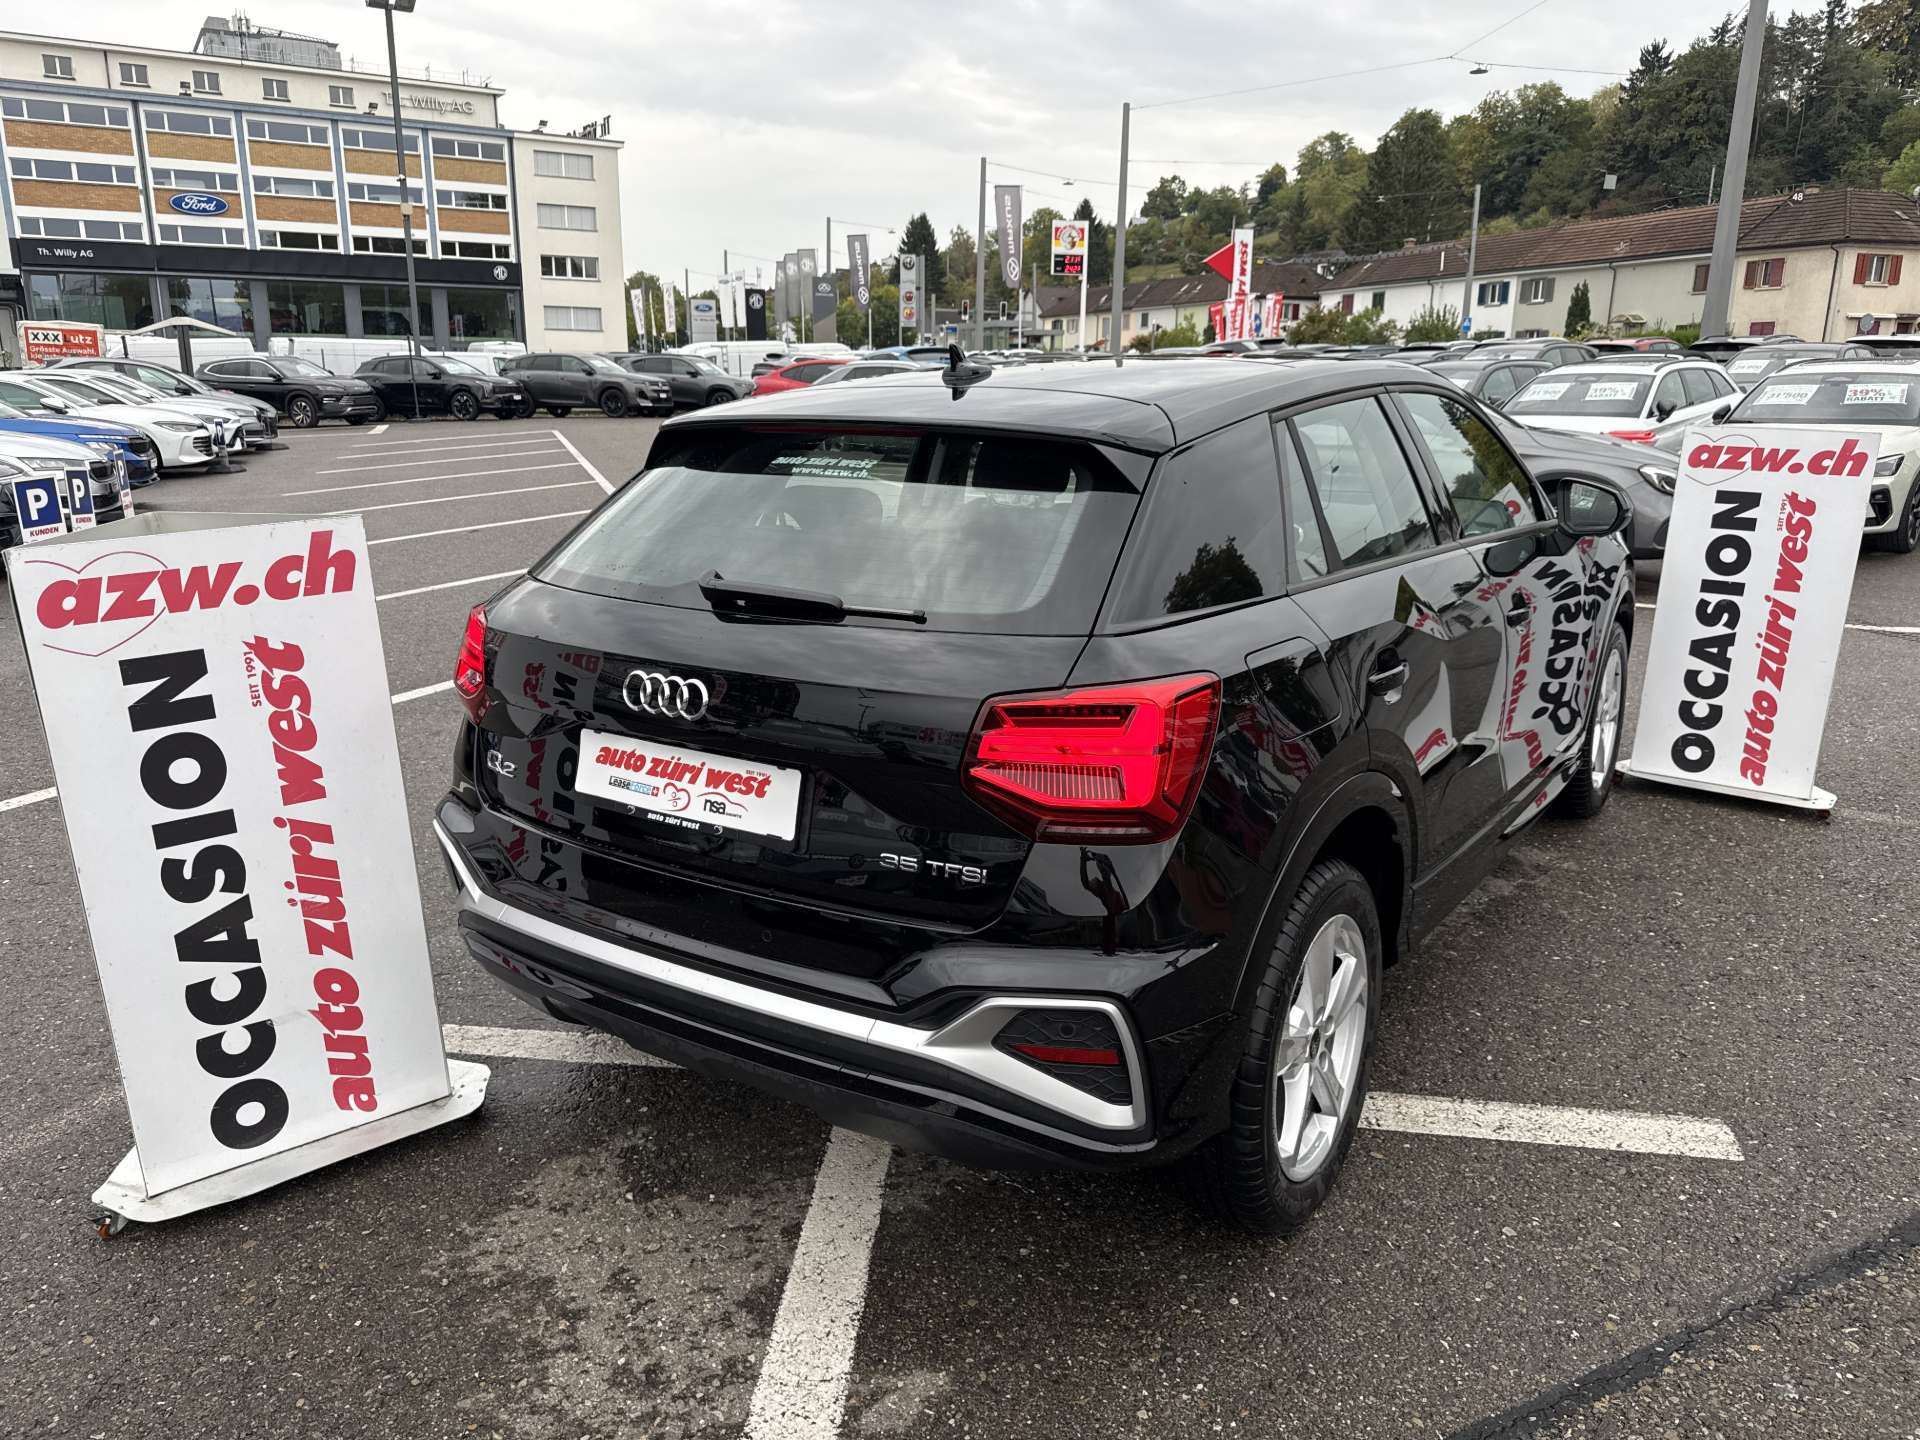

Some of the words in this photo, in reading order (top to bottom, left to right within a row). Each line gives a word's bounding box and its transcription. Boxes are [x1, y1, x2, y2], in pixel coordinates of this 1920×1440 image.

[411, 95, 446, 114] Willy
[452, 99, 474, 113] AG
[181, 195, 217, 211] Ford
[1792, 192, 1804, 201] 48
[37, 247, 51, 256] Th.
[53, 248, 77, 259] Willy
[79, 250, 94, 258] AG
[771, 456, 808, 465] auto
[838, 458, 878, 468] west
[791, 466, 869, 477] www.azw.ch
[1687, 439, 1868, 477] azw.ch
[25, 488, 48, 521] P
[71, 478, 85, 509] P
[30, 526, 59, 537] KUNDEN
[1776, 517, 1784, 532] SEIT
[1773, 491, 1817, 593] west
[36, 530, 356, 630] azw.ch
[1671, 489, 1762, 773] OCCASION
[1755, 595, 1796, 692] züri
[243, 651, 257, 679] 1991
[248, 683, 262, 708] SEIT
[242, 634, 327, 806] west
[1741, 690, 1778, 786] auto
[487, 749, 515, 778] Q2
[595, 746, 646, 773] auto
[645, 755, 706, 785] züri
[705, 767, 772, 799] west
[647, 812, 664, 822] auto
[664, 815, 682, 826] züri
[681, 819, 700, 831] west
[703, 798, 727, 815] nsa
[879, 852, 919, 873] 35
[925, 859, 988, 885] TFSI
[119, 648, 289, 1150] OCCASION
[271, 816, 354, 960] züri
[308, 963, 377, 1113] auto
